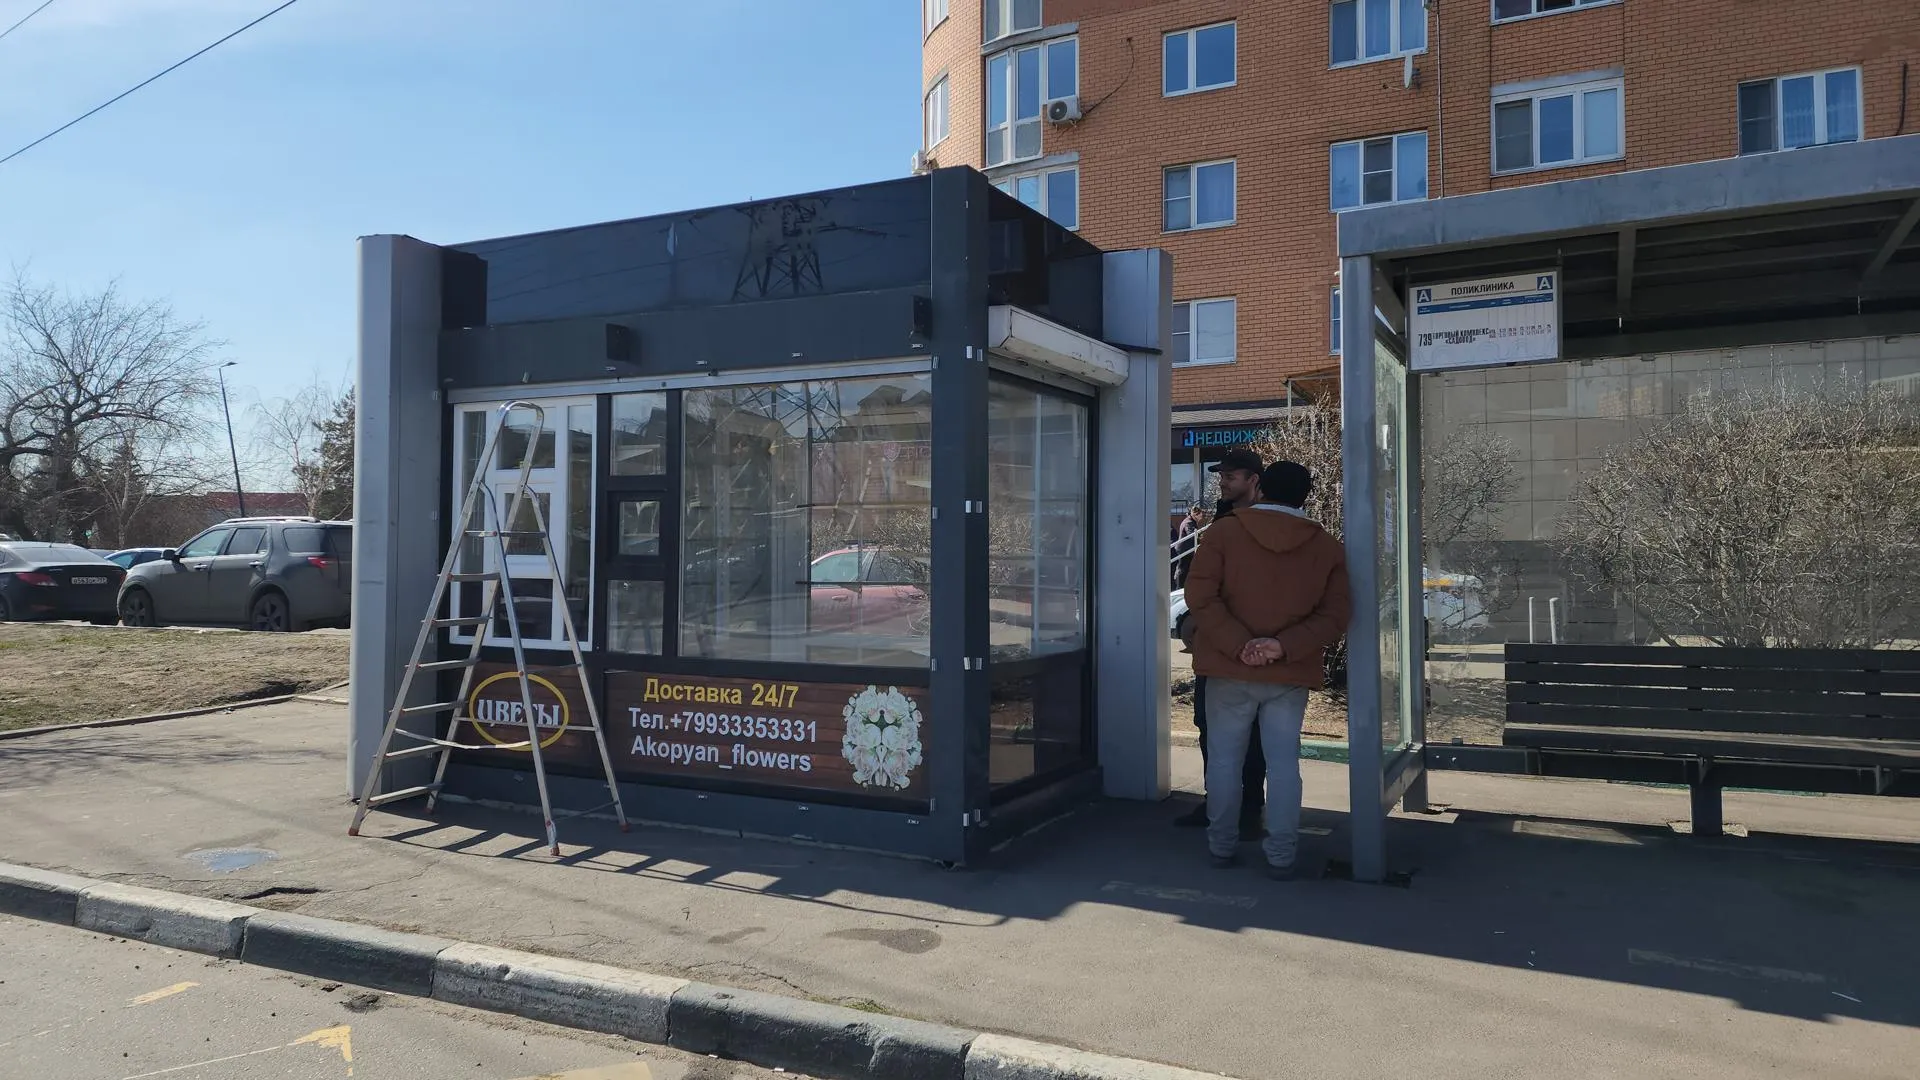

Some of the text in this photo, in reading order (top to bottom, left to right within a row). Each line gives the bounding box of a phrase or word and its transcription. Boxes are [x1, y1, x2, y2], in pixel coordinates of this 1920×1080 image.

[1451, 281, 1515, 296] ПОЛИКЛИНИКА
[1418, 332, 1433, 347] 739
[1195, 428, 1262, 446] НЕДВИЖ
[643, 678, 799, 708] Доставка 24/7
[628, 707, 816, 743] Тел.+79933353331
[630, 735, 812, 772] Akopyan_flowers
